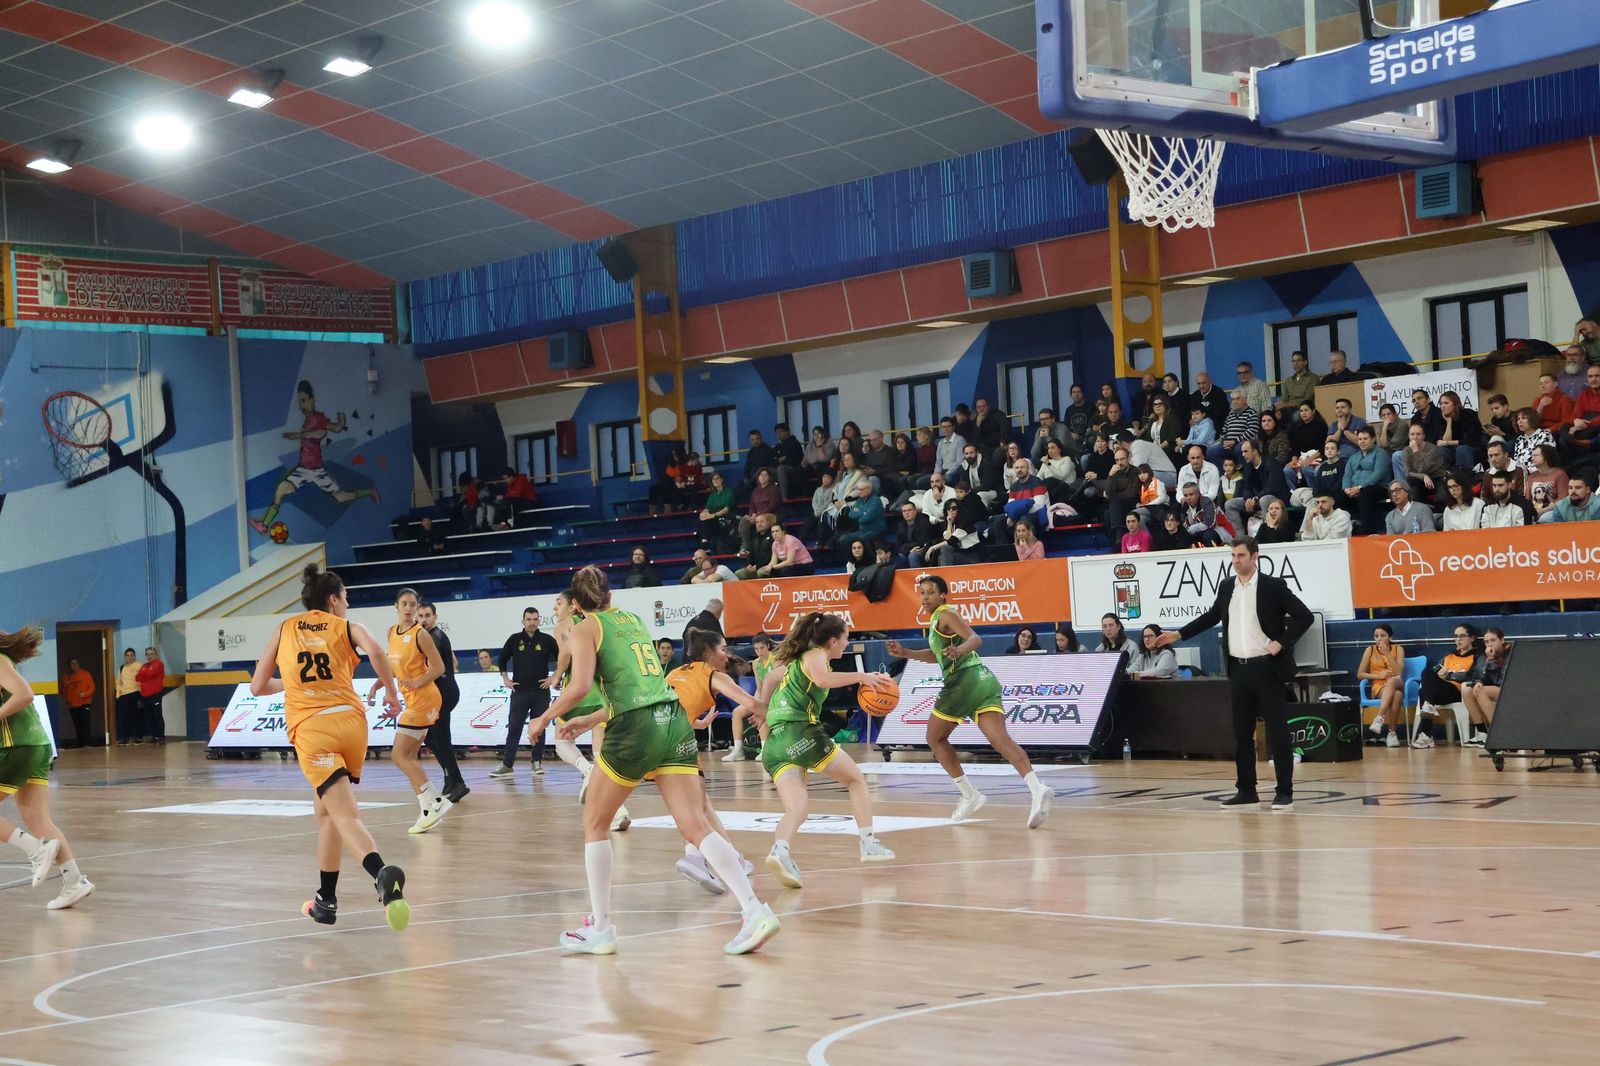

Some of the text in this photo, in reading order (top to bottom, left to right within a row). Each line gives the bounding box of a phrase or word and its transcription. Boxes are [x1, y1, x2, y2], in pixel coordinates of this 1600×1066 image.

[1369, 24, 1475, 65] Schelde
[1369, 44, 1477, 85] Sports
[76, 273, 190, 292] AYUNTAMIENTO
[76, 288, 191, 311] DE ZAMORA
[1439, 546, 1540, 572] recoletas
[1156, 554, 1303, 599] ZAMRA
[665, 606, 697, 619] ZAMORA
[297, 651, 333, 683] 28
[630, 641, 660, 677] 15
